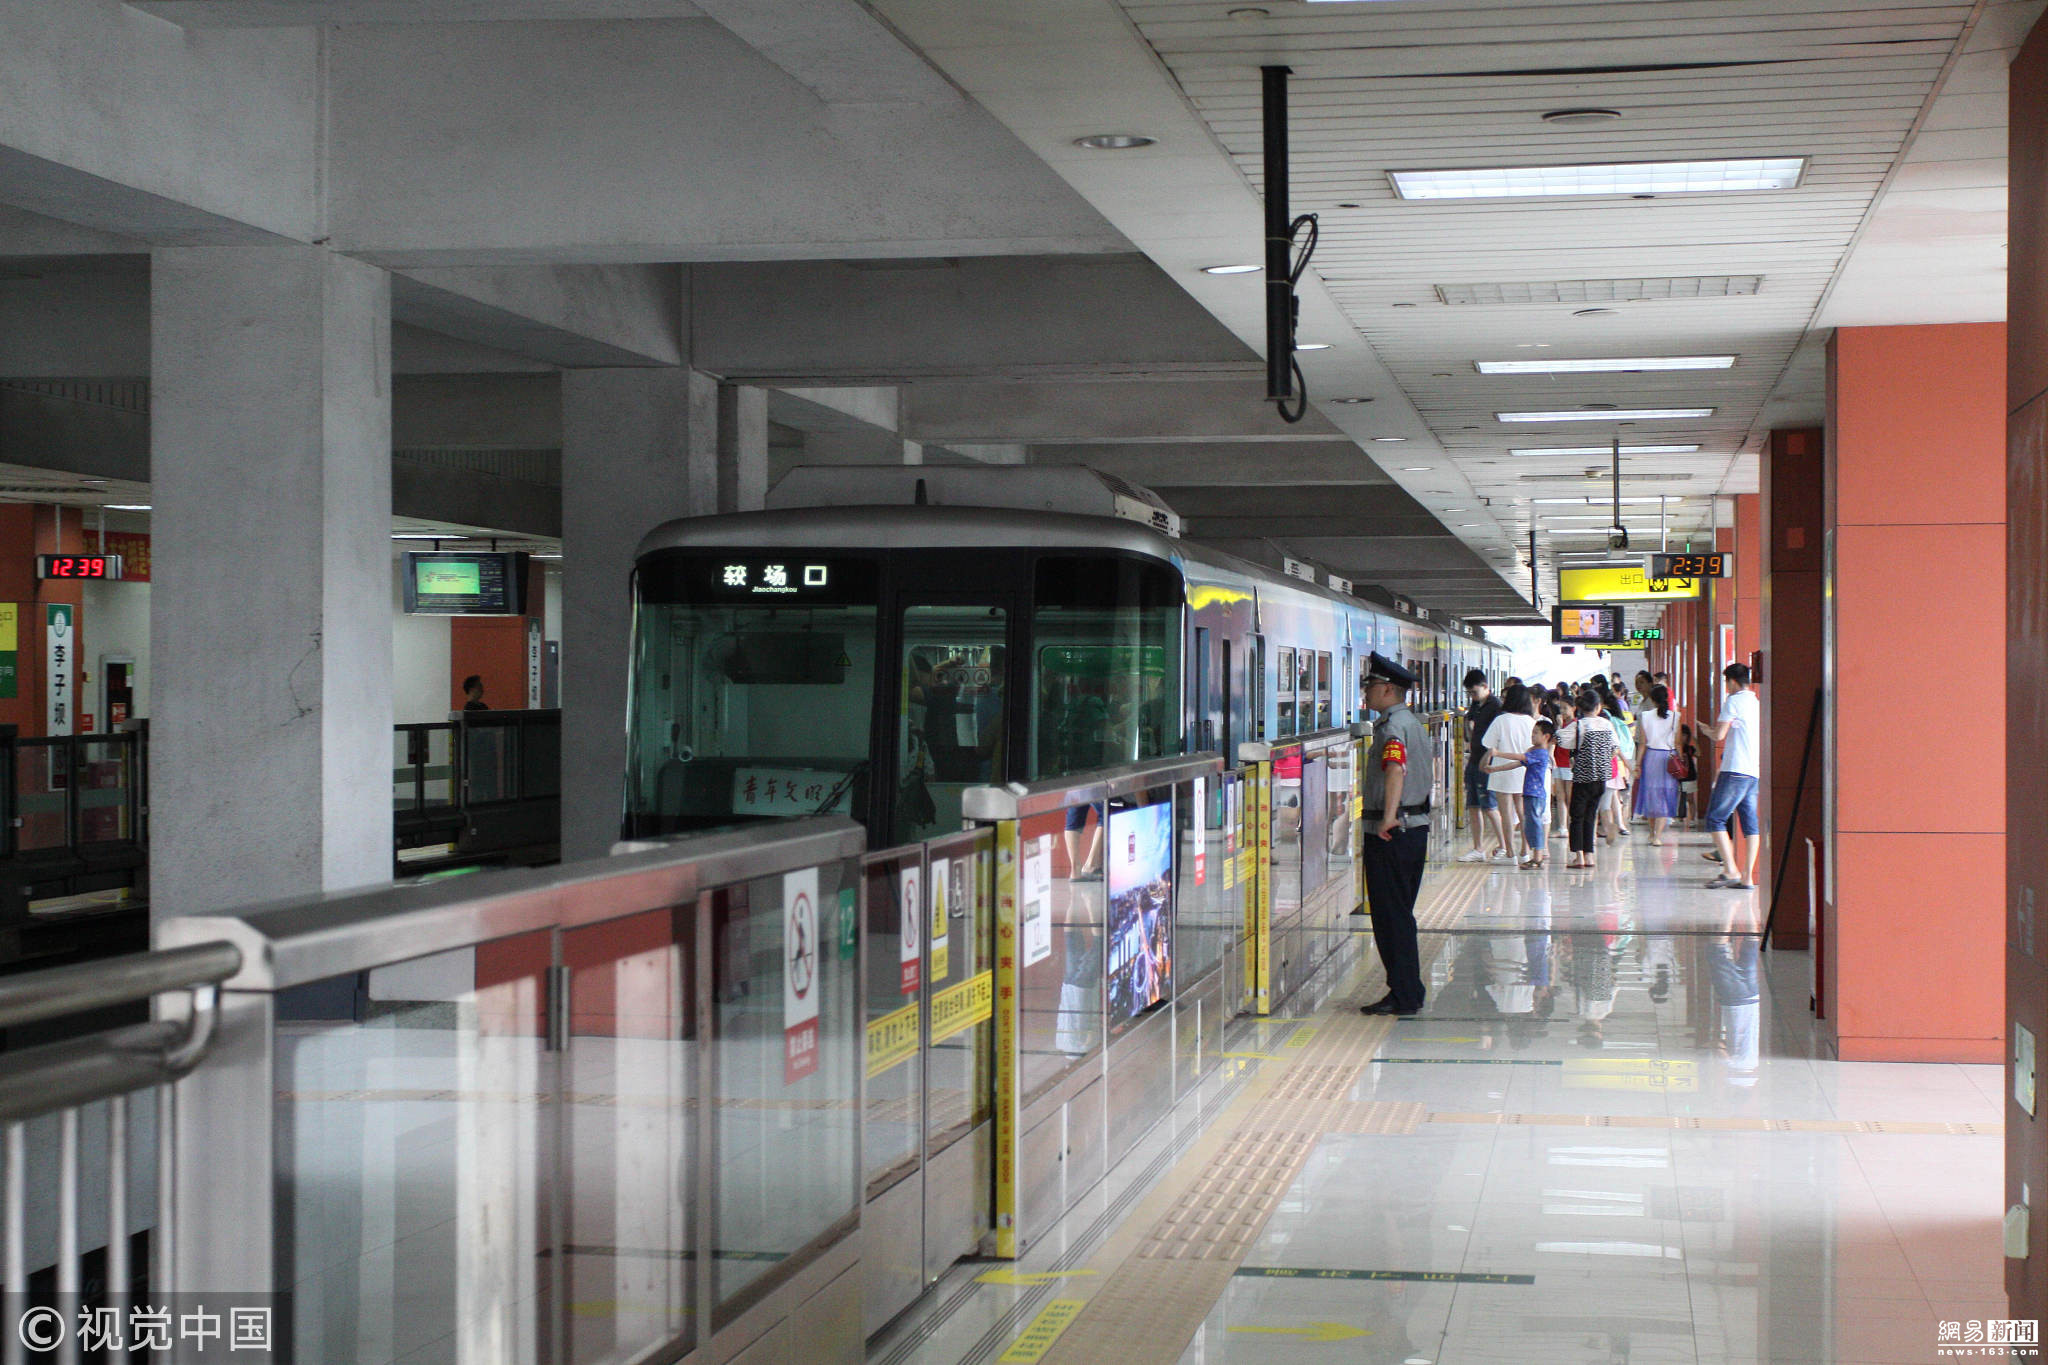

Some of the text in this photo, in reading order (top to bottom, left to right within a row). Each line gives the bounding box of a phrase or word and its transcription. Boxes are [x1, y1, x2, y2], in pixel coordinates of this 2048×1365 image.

[723, 564, 827, 586] 较场口
[1665, 556, 1721, 575] 12:39
[751, 586, 798, 594] Jiaochangkou
[1621, 574, 1643, 585] 出口
[54, 644, 66, 736] 李子坝
[841, 905, 854, 946] 12
[1000, 895, 1013, 1000] 当心夹手
